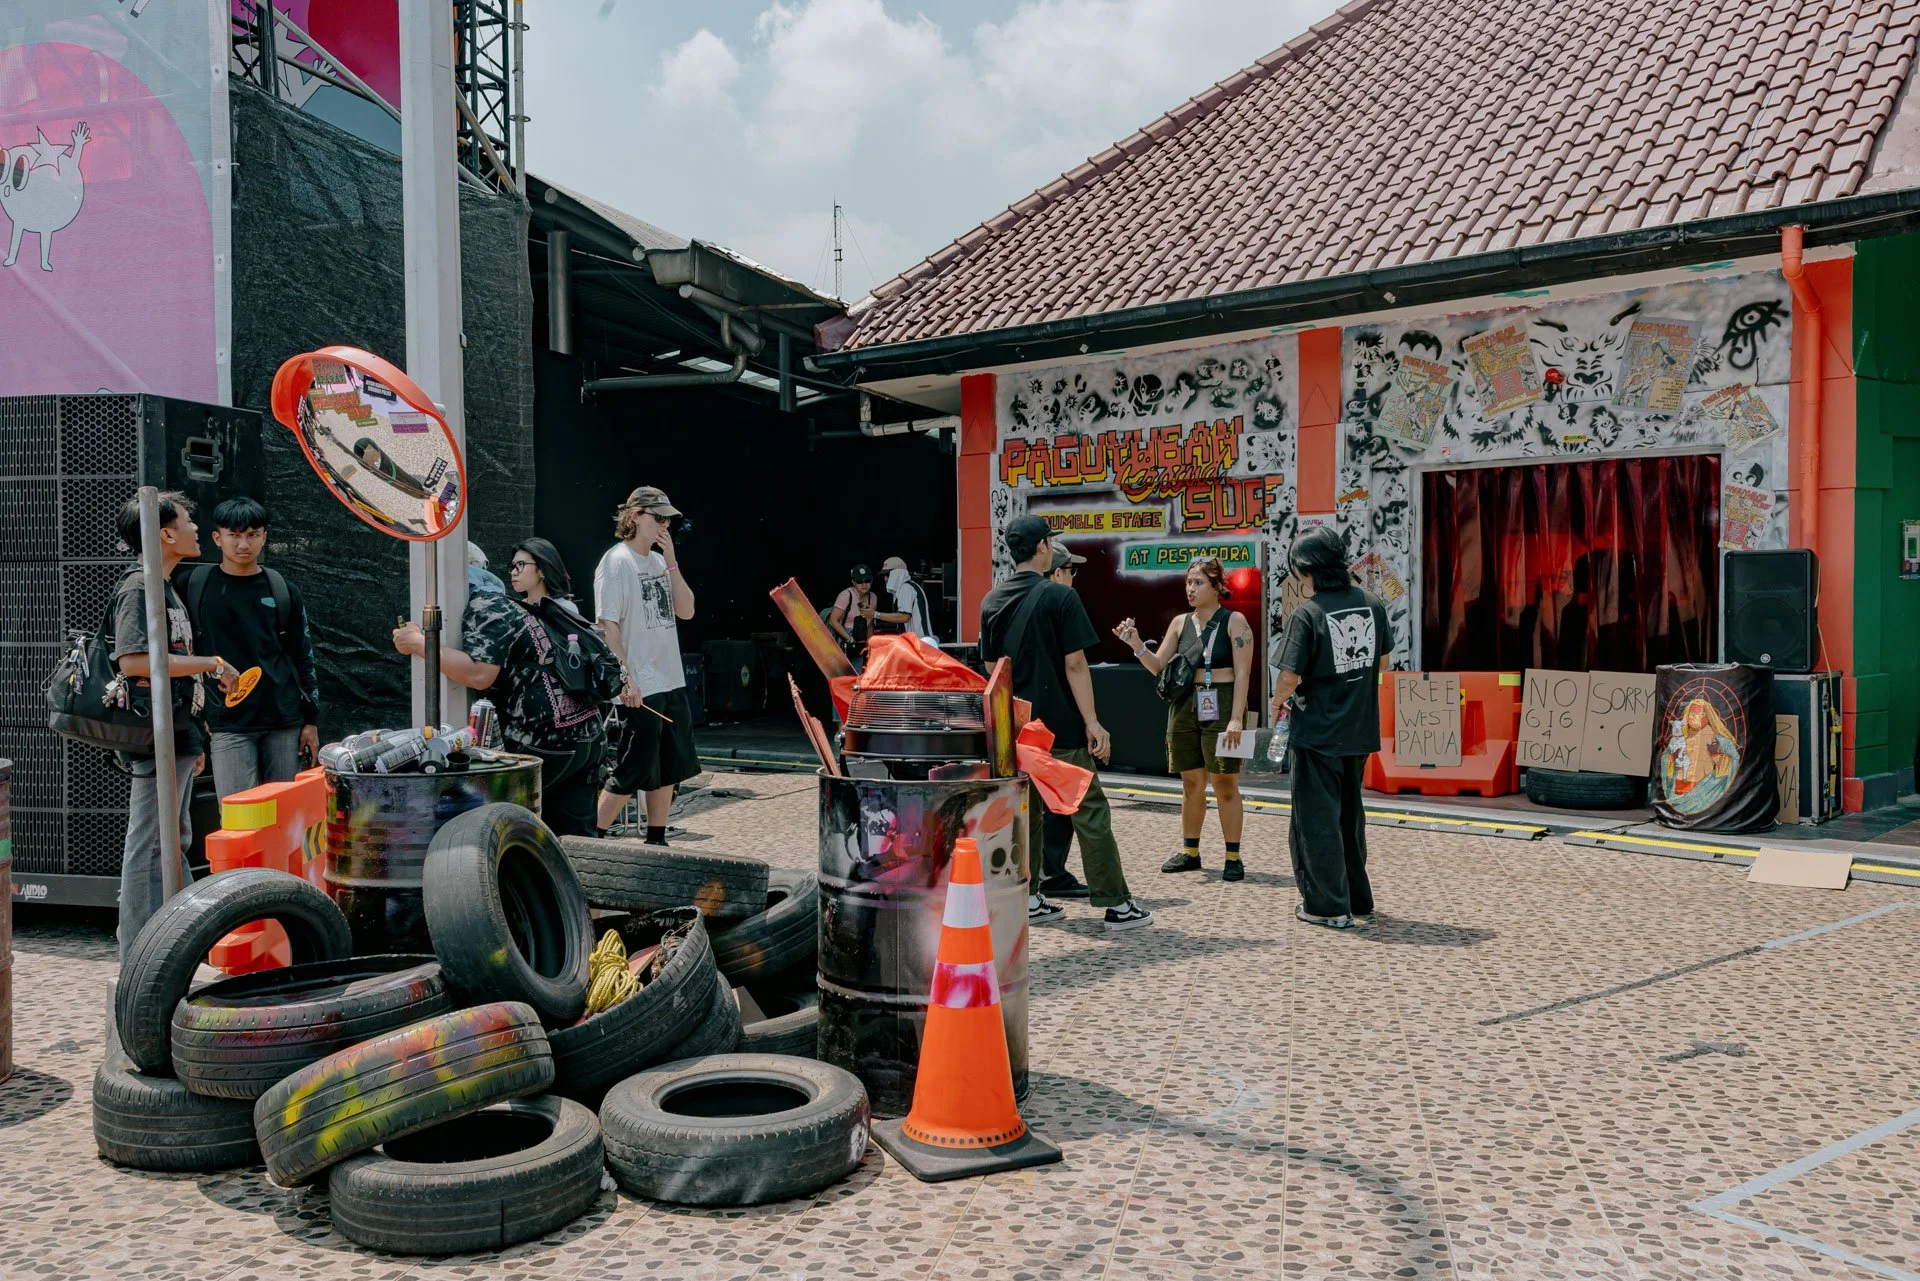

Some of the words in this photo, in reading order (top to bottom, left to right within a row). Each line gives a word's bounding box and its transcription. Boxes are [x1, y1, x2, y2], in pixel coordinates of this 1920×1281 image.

[1000, 415, 1244, 487] PAGUYUBAN
[1112, 511, 1163, 529] STAGE
[1128, 549, 1150, 566] AT
[1157, 545, 1250, 564] PESTAPORA
[1398, 678, 1455, 705] FREE
[1530, 677, 1577, 708] NO
[1591, 682, 1657, 714] SORRY
[1399, 708, 1457, 728] WEST
[1525, 708, 1574, 729] GIG
[1398, 729, 1458, 757] PAPUA
[1541, 729, 1552, 741] 4
[1519, 740, 1577, 767] TODAY
[20, 883, 48, 900] AUDIO
